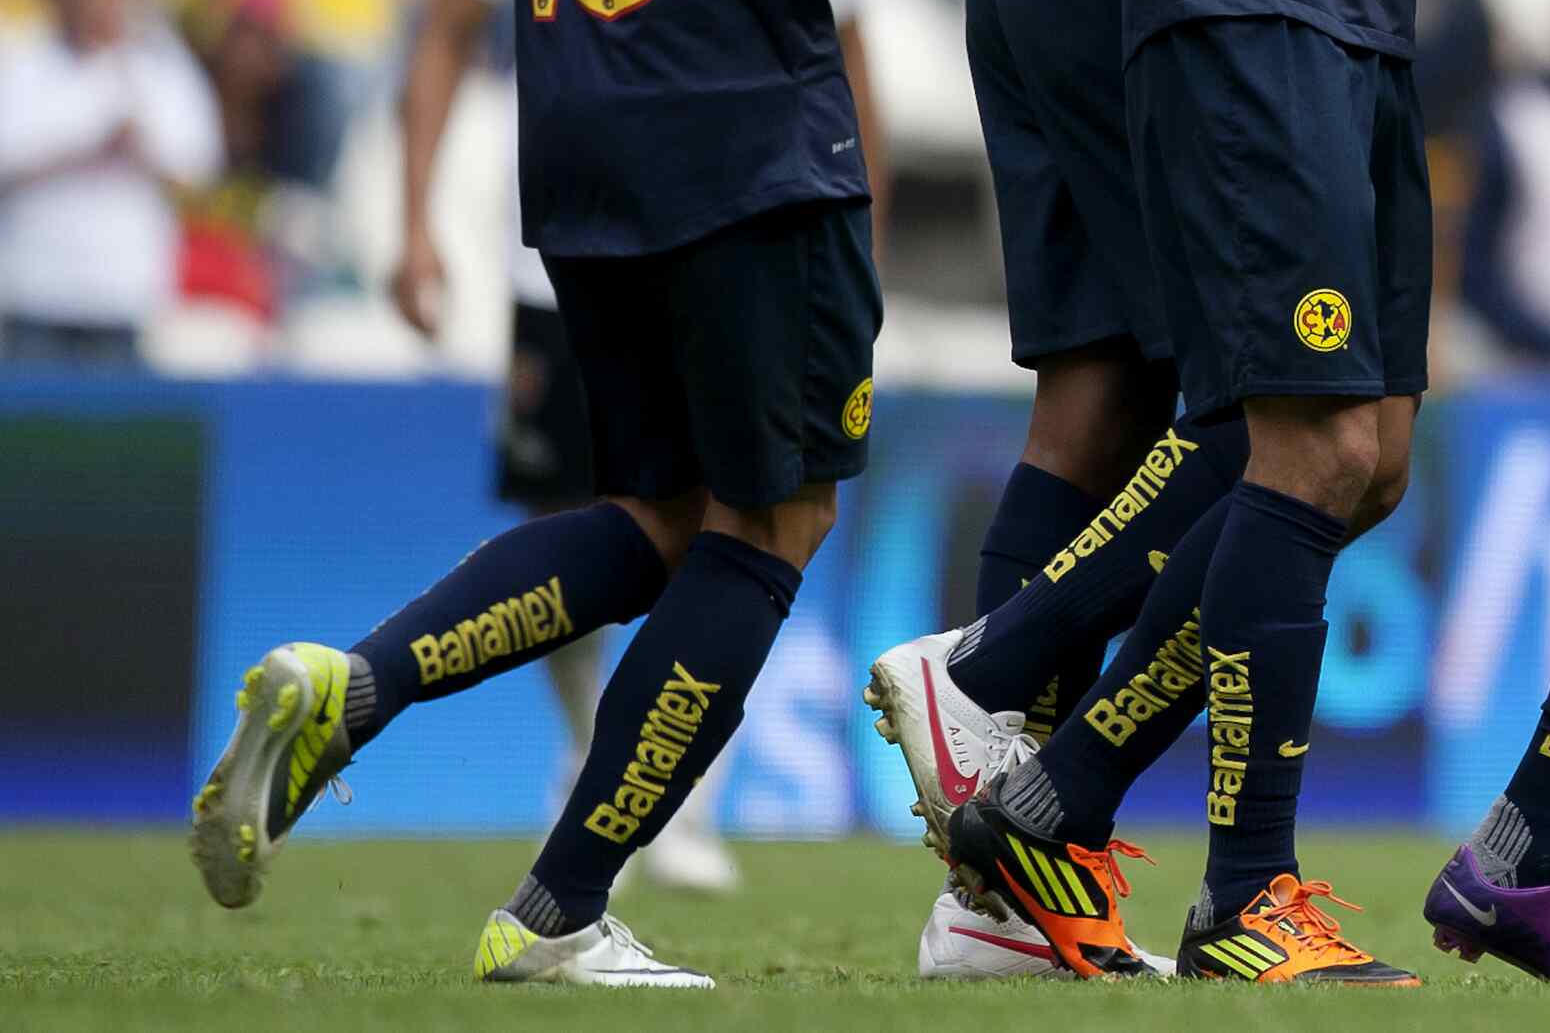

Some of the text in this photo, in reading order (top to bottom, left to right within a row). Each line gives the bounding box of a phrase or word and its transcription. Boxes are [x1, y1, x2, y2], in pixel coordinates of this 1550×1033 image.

[1044, 427, 1200, 584] Banamex
[410, 575, 574, 684] Banamex
[1084, 606, 1204, 748] Baname
[584, 661, 722, 844] Banamex
[1206, 646, 1251, 826] Banamex
